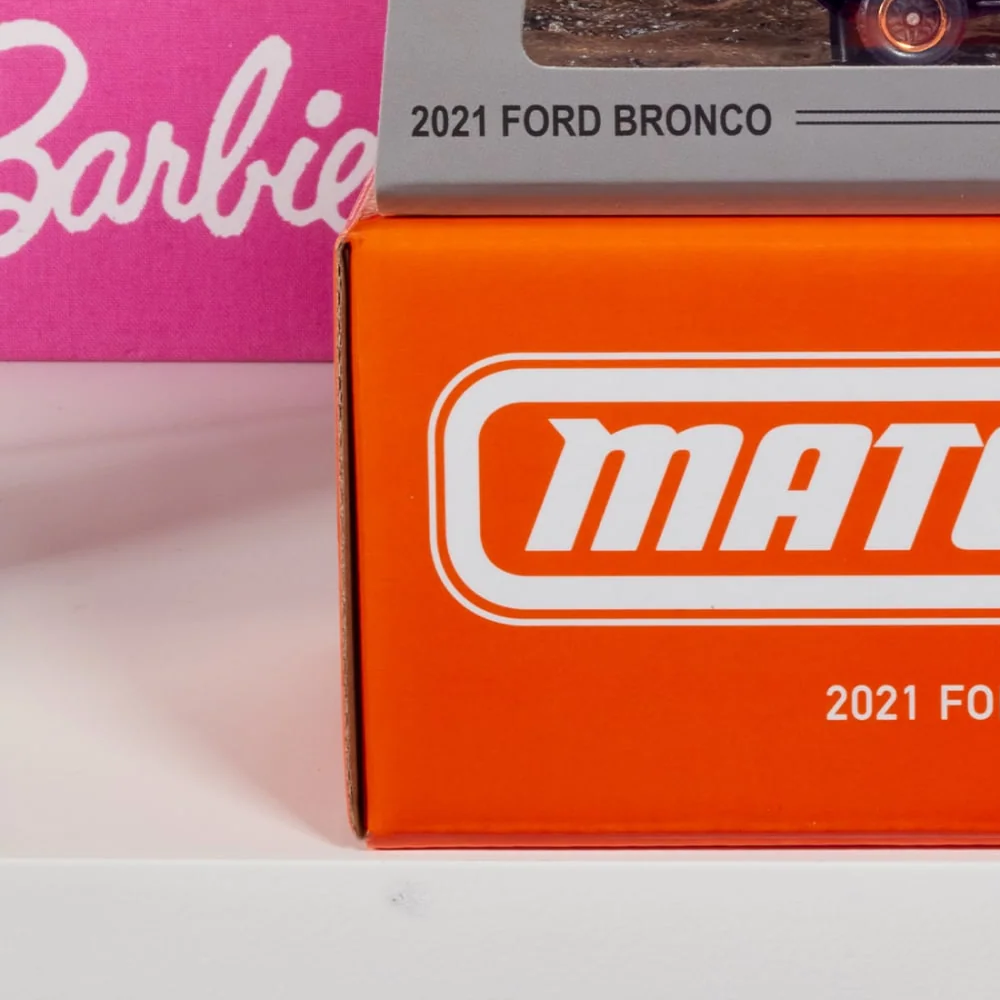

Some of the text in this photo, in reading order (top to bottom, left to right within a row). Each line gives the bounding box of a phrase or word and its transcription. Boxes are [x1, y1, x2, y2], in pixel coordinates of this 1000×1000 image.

[0, 18, 379, 258] Barbie
[411, 103, 772, 137] 2021 FORD BRONCO
[825, 684, 917, 721] 2021
